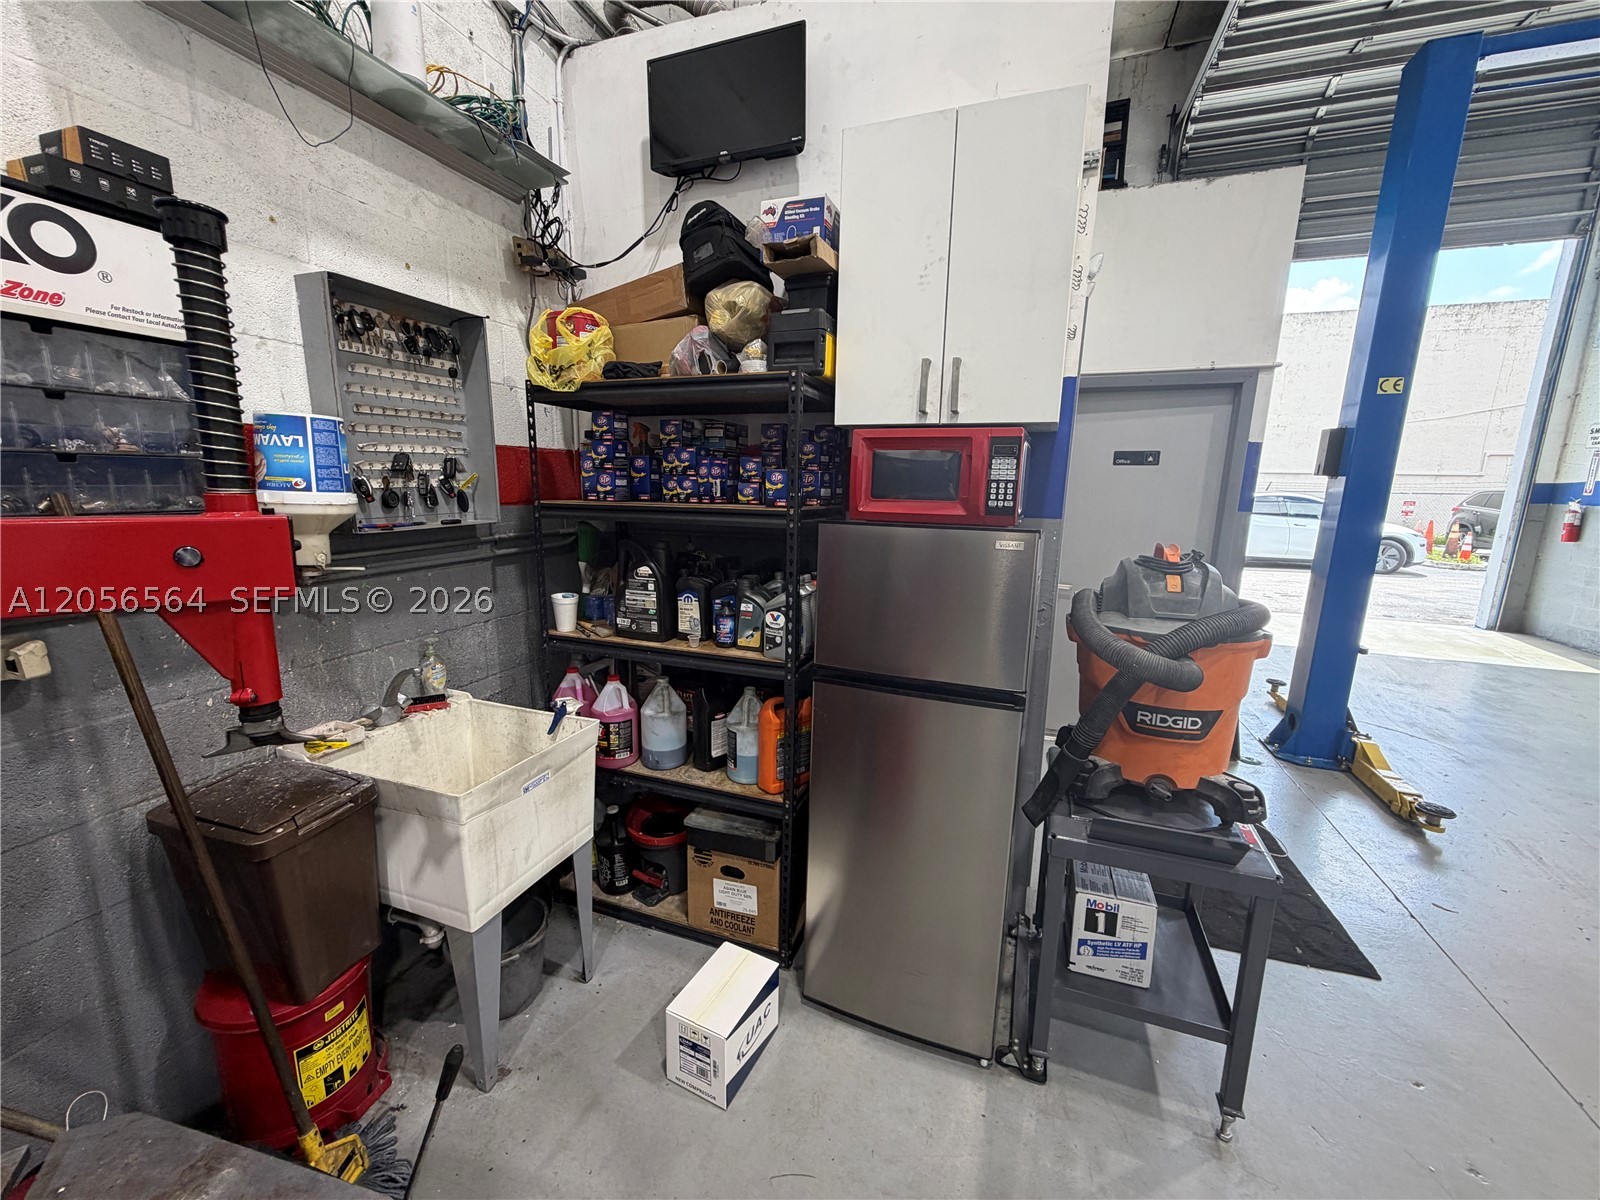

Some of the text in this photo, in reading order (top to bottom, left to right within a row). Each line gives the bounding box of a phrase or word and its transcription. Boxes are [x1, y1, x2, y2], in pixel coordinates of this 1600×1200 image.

[85, 307, 106, 316] Please
[107, 311, 131, 320] Contact
[122, 306, 144, 316] Restock
[1137, 711, 1202, 729] RIDGID
[1086, 898, 1120, 913] Mobil
[710, 908, 755, 926] ANTIFREEZE
[710, 917, 755, 935] AND COOLANT
[1095, 912, 1105, 933] 1
[325, 1010, 358, 1044] JUSTRITE
[746, 1002, 771, 1045] UAC
[315, 1060, 335, 1078] EMPTY
[336, 1048, 352, 1064] EVERY
[686, 1081, 716, 1101] COMPRESSOR
